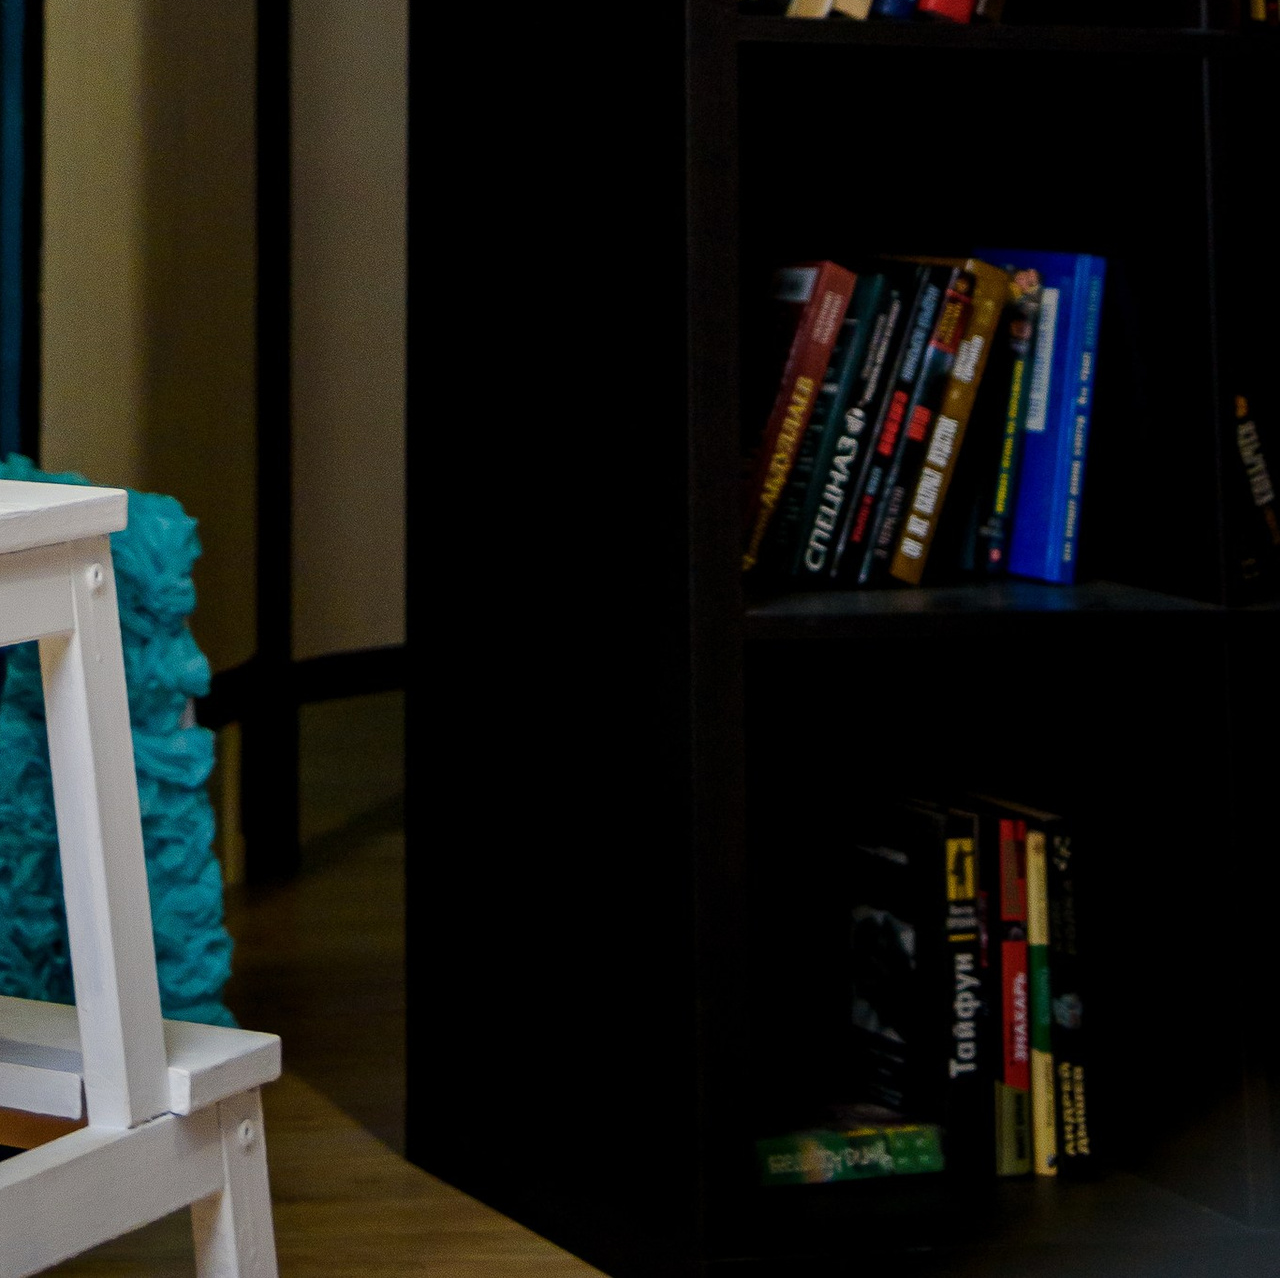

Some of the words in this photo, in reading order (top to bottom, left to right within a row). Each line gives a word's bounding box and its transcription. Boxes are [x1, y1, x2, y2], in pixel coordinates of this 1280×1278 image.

[760, 376, 814, 508] АБДУЛЛАЕВ
[804, 435, 859, 571] СПЕЦНАЗ
[949, 953, 981, 1077] Тайфун
[1013, 971, 1029, 1062] ЗНАХАРЬ
[1059, 1061, 1076, 1156] АНДРЕЙ
